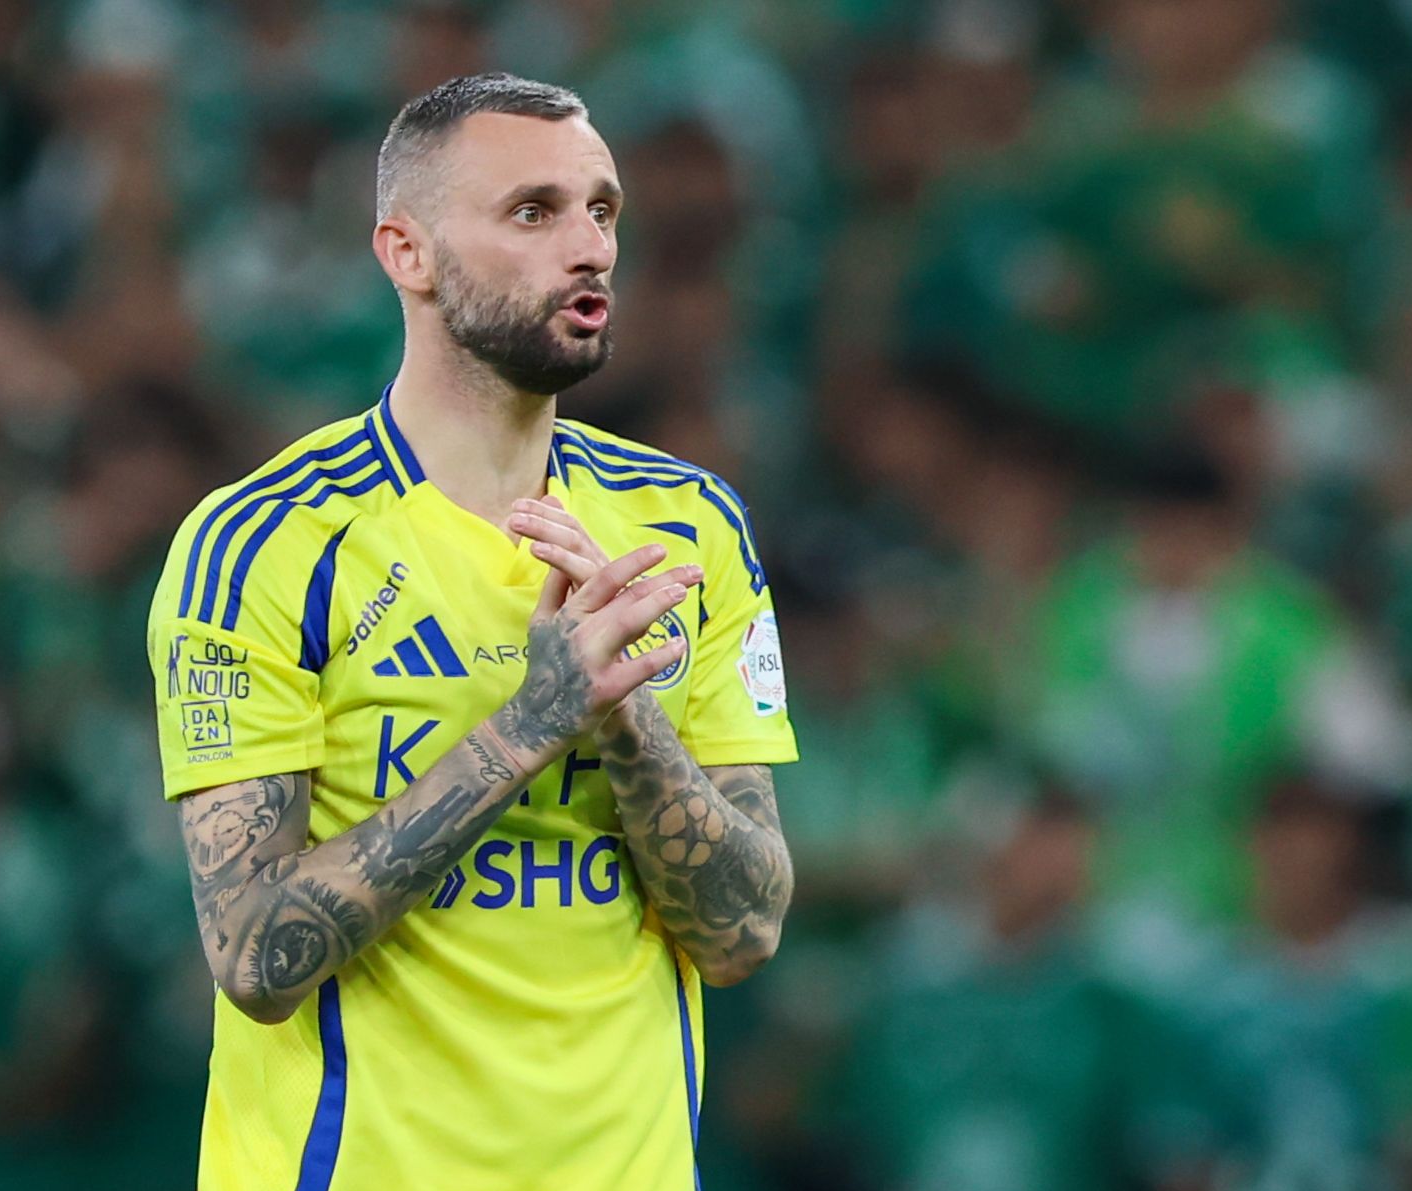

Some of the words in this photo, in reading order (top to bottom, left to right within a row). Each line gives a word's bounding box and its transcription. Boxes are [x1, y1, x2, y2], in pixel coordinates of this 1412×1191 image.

[758, 654, 780, 672] RSL
[188, 668, 250, 699] NOUG
[471, 835, 620, 909] SHG
